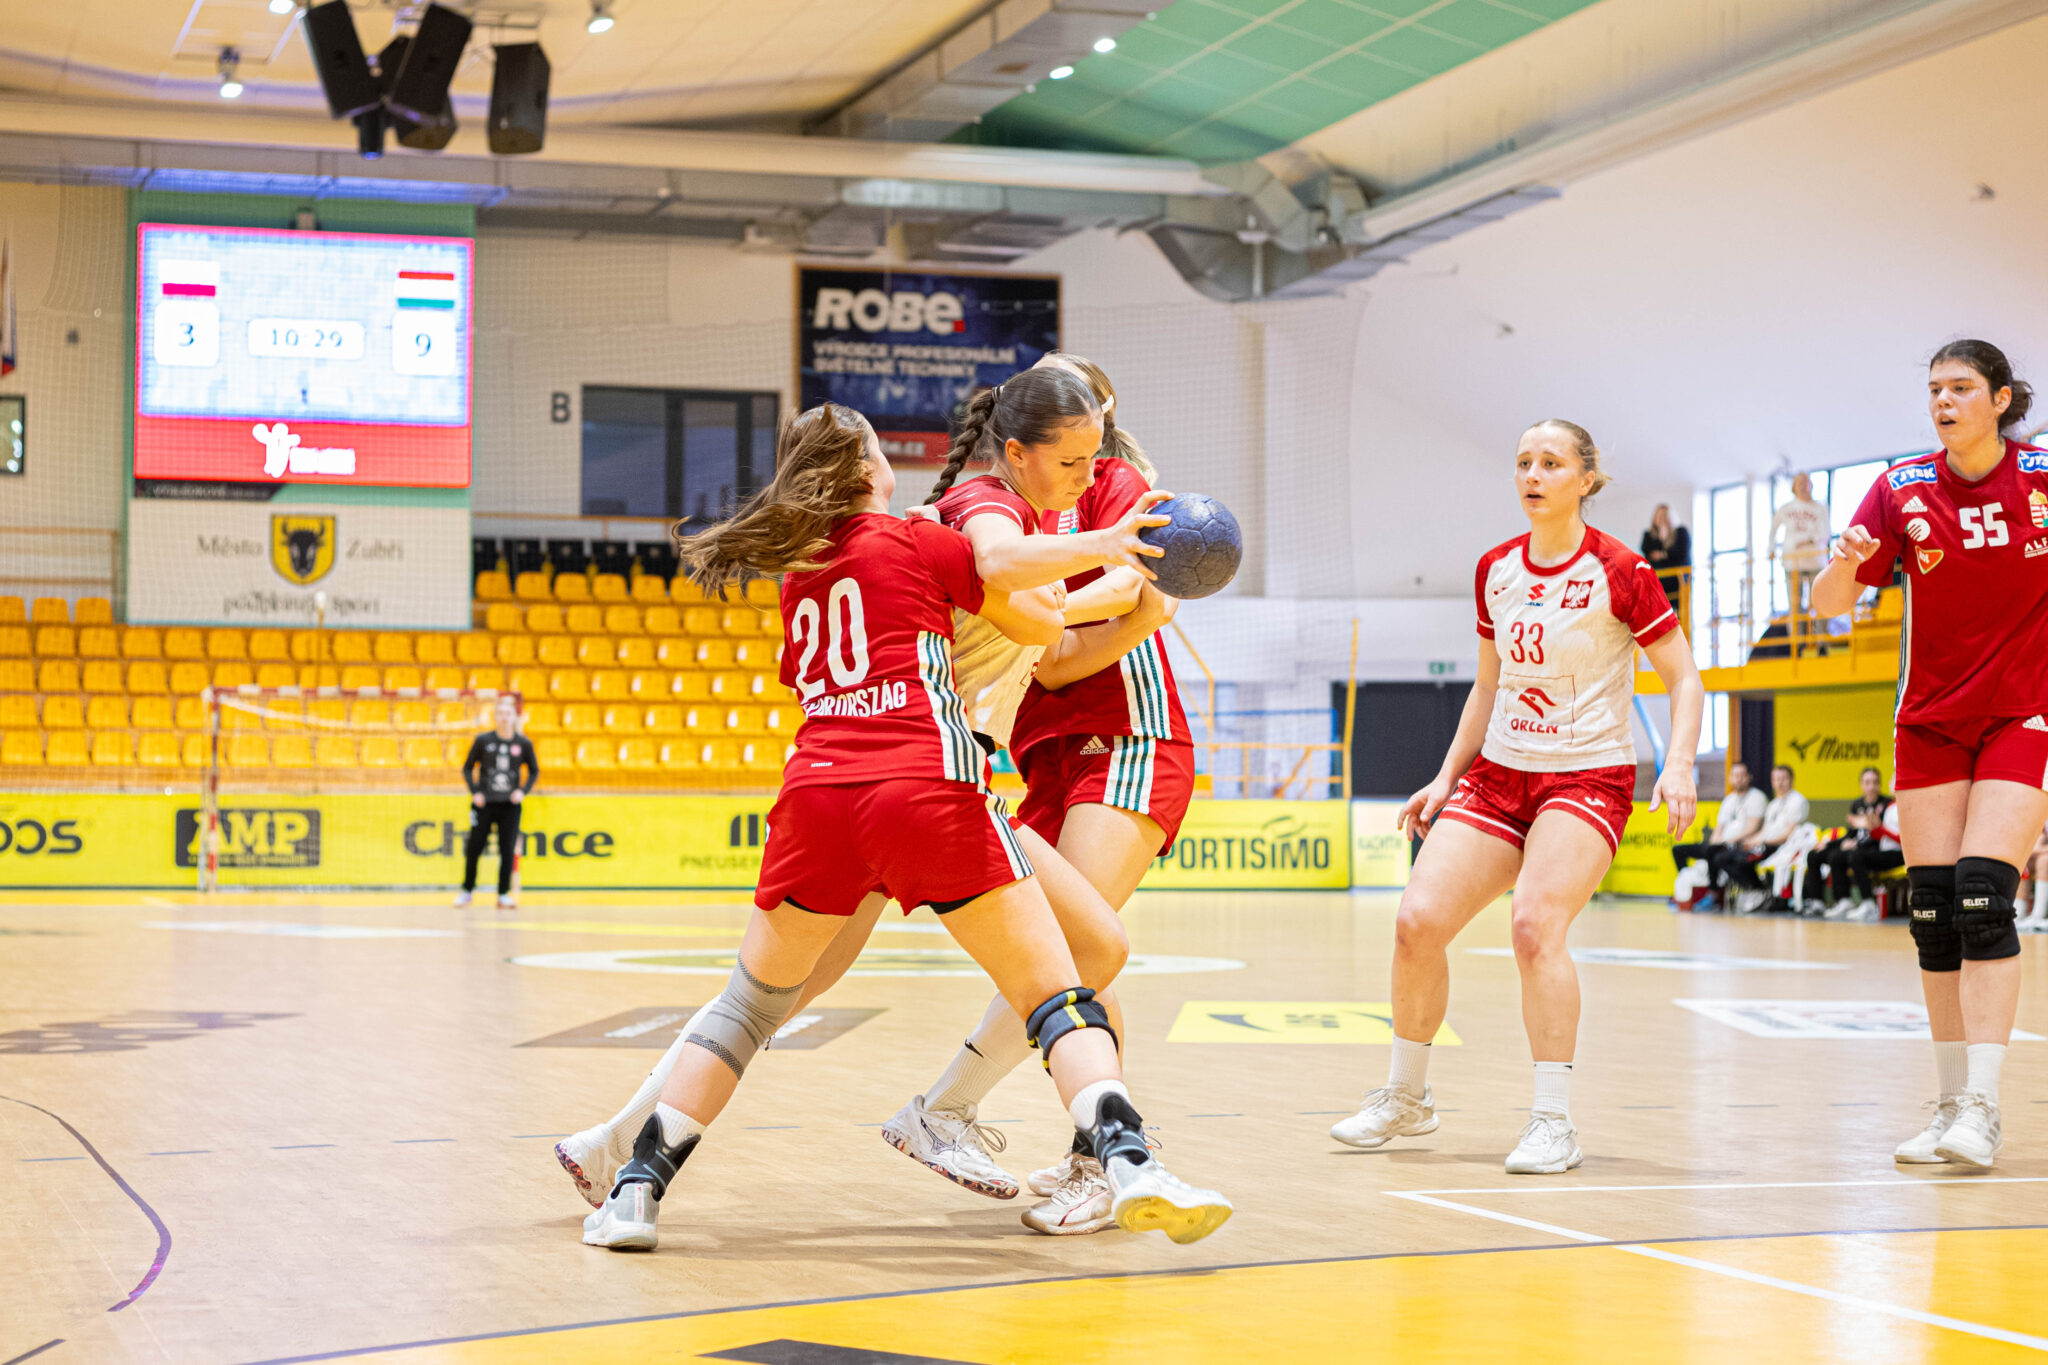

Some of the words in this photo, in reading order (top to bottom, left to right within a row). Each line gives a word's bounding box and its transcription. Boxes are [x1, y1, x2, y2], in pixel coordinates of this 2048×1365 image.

[178, 322, 195, 348] 3
[415, 332, 432, 358] 9
[551, 391, 571, 424] B
[1900, 467, 1936, 482] JYSK
[1958, 502, 2010, 550] 55
[791, 577, 870, 705] 20
[1510, 620, 1544, 665] 33
[1510, 717, 1558, 735] ORLEN
[1079, 747, 1110, 756] adidas
[403, 820, 614, 859] Chnce
[1963, 897, 1990, 907] SELECT
